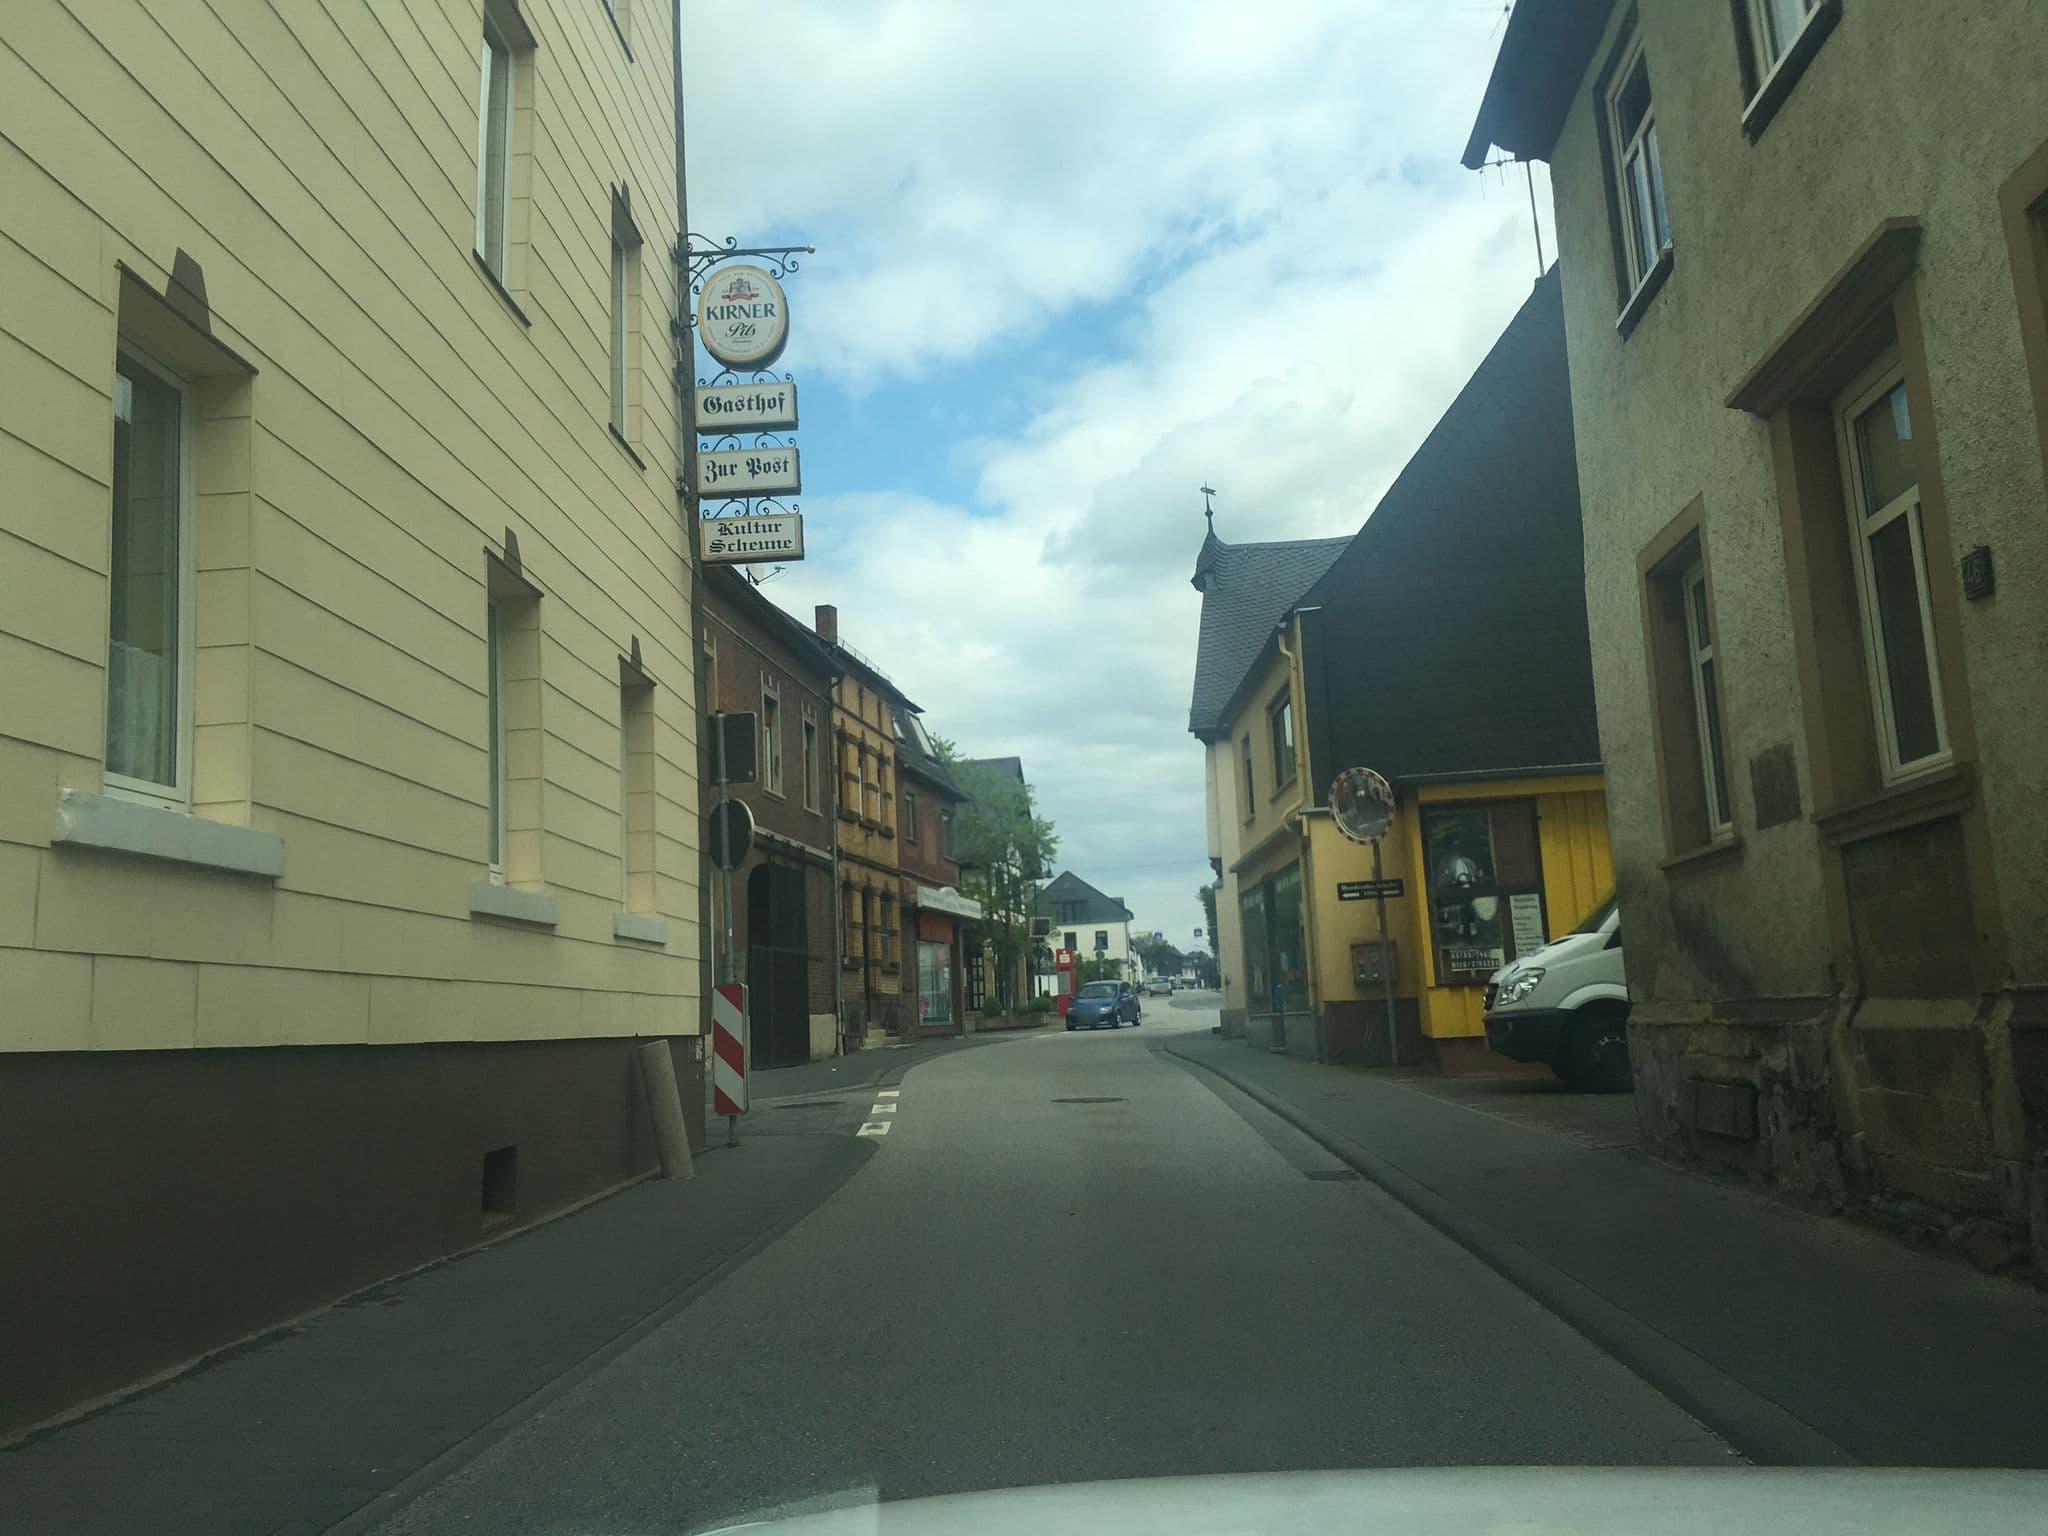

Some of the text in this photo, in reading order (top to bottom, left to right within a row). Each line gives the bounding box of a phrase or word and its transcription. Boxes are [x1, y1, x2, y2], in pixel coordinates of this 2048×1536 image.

[706, 303, 776, 321] KIRNER
[725, 322, 756, 337] Pils
[703, 392, 785, 416] Gasthof
[705, 456, 790, 483] Zur Post
[717, 521, 783, 537] Kultur
[709, 538, 793, 554] Scheune
